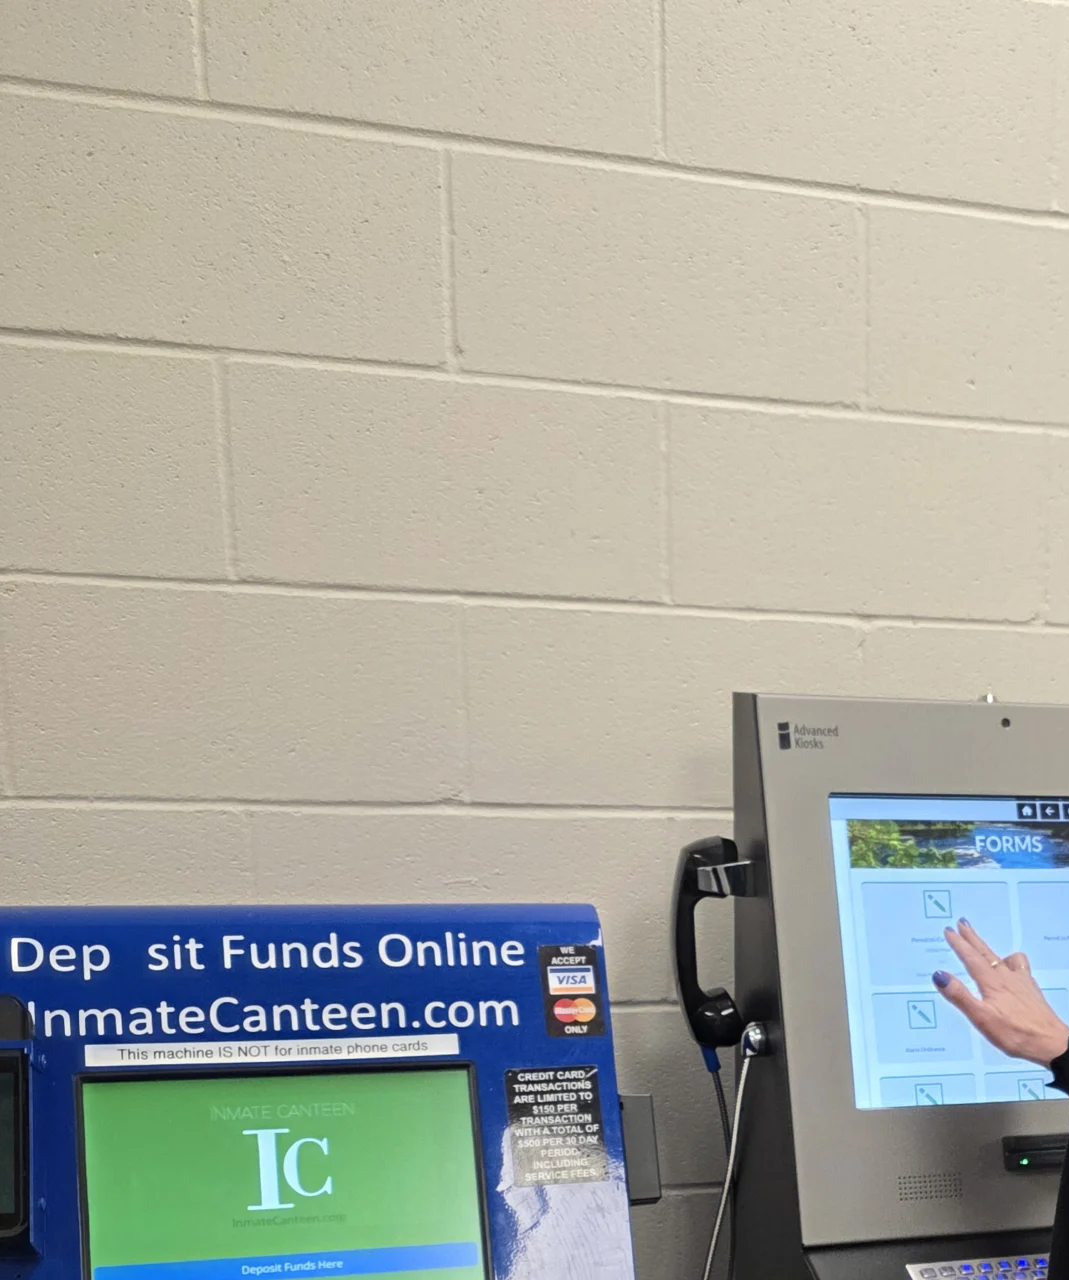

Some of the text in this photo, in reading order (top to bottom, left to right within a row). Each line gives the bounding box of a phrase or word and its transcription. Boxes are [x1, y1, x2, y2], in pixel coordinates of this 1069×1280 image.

[794, 724, 839, 737] Advanced
[794, 738, 824, 749] Kiosks
[974, 835, 1043, 853] FORMS
[222, 932, 364, 969] Funds
[378, 932, 525, 967] Online
[551, 956, 586, 965] ACCEPT
[557, 976, 588, 985] VISA
[28, 996, 519, 1037] InmateCanteen.com
[564, 1025, 589, 1034] ONLY
[118, 1040, 428, 1061] This machine IS NOT for inmate phone cards
[517, 1070, 586, 1081] CREDIT CARD
[513, 1081, 592, 1092] TRANSACTIONS
[513, 1092, 593, 1104] ARE LIMITED TO
[210, 1102, 356, 1121] INMATE CANTEEN
[532, 1104, 578, 1114] $150 PER
[520, 1114, 592, 1126] TRANSACTION
[514, 1124, 600, 1137] WITH A TOTAL OF
[542, 1138, 564, 1146] PER
[578, 1135, 599, 1145] DAY
[541, 1148, 580, 1158] PERIOD
[533, 1159, 588, 1169] INCLUDING
[525, 1170, 569, 1182] SERVICE
[232, 1213, 347, 1228] InmateCanteen.com
[241, 1260, 344, 1276] Deposit Funds Here
